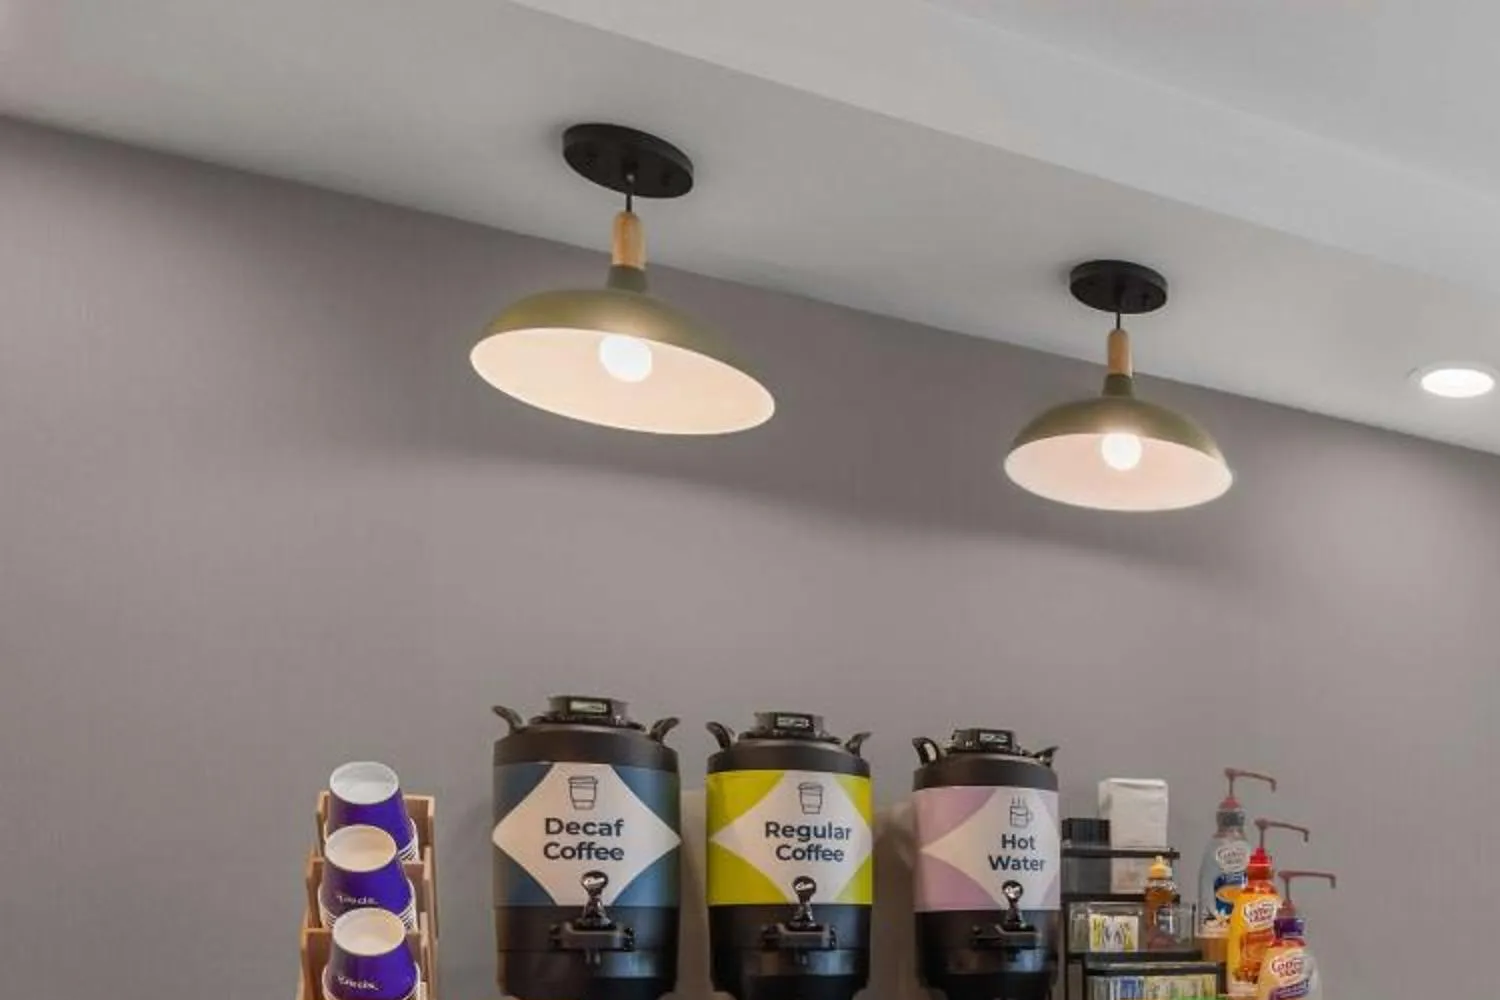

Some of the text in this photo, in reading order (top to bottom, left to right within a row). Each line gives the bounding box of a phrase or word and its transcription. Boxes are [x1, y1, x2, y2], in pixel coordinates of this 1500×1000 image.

[545, 818, 624, 837] Decaf
[765, 821, 852, 842] Regular
[1001, 833, 1036, 850] Hot
[543, 841, 625, 861] Coffee
[775, 844, 844, 862] Coffee
[988, 854, 1046, 872] Water
